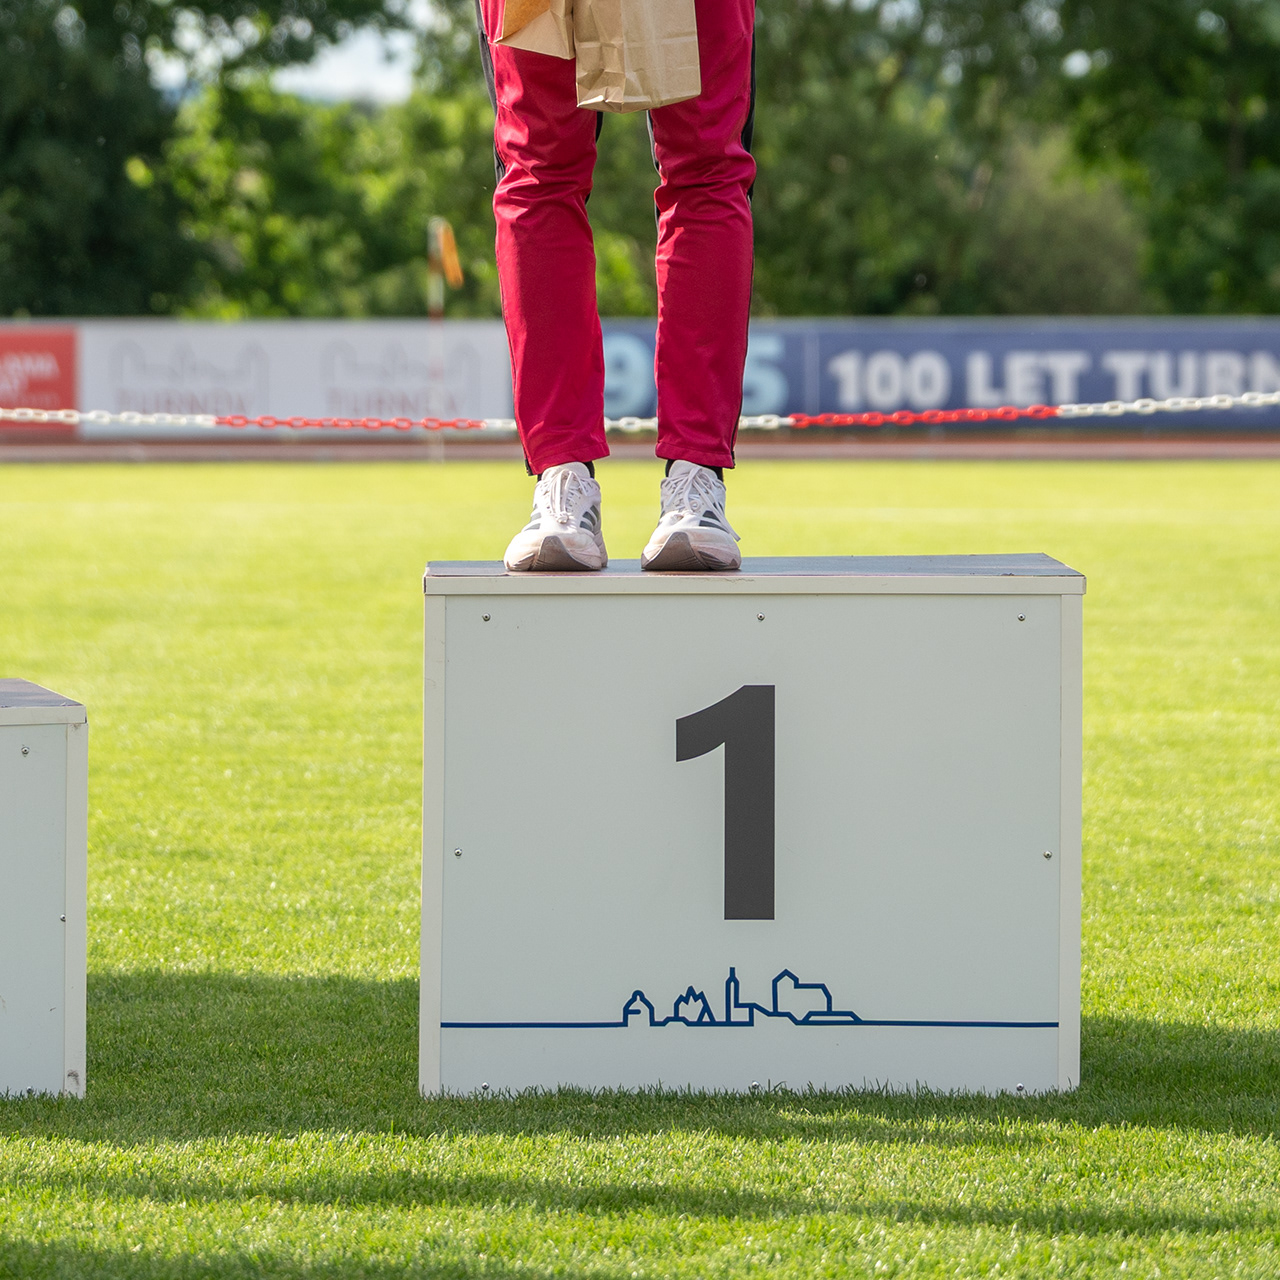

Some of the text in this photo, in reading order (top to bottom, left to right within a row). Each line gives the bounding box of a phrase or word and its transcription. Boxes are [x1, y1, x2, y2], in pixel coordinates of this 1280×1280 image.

[829, 350, 951, 408] 100
[967, 350, 1090, 410] LET
[675, 683, 778, 921] 1
